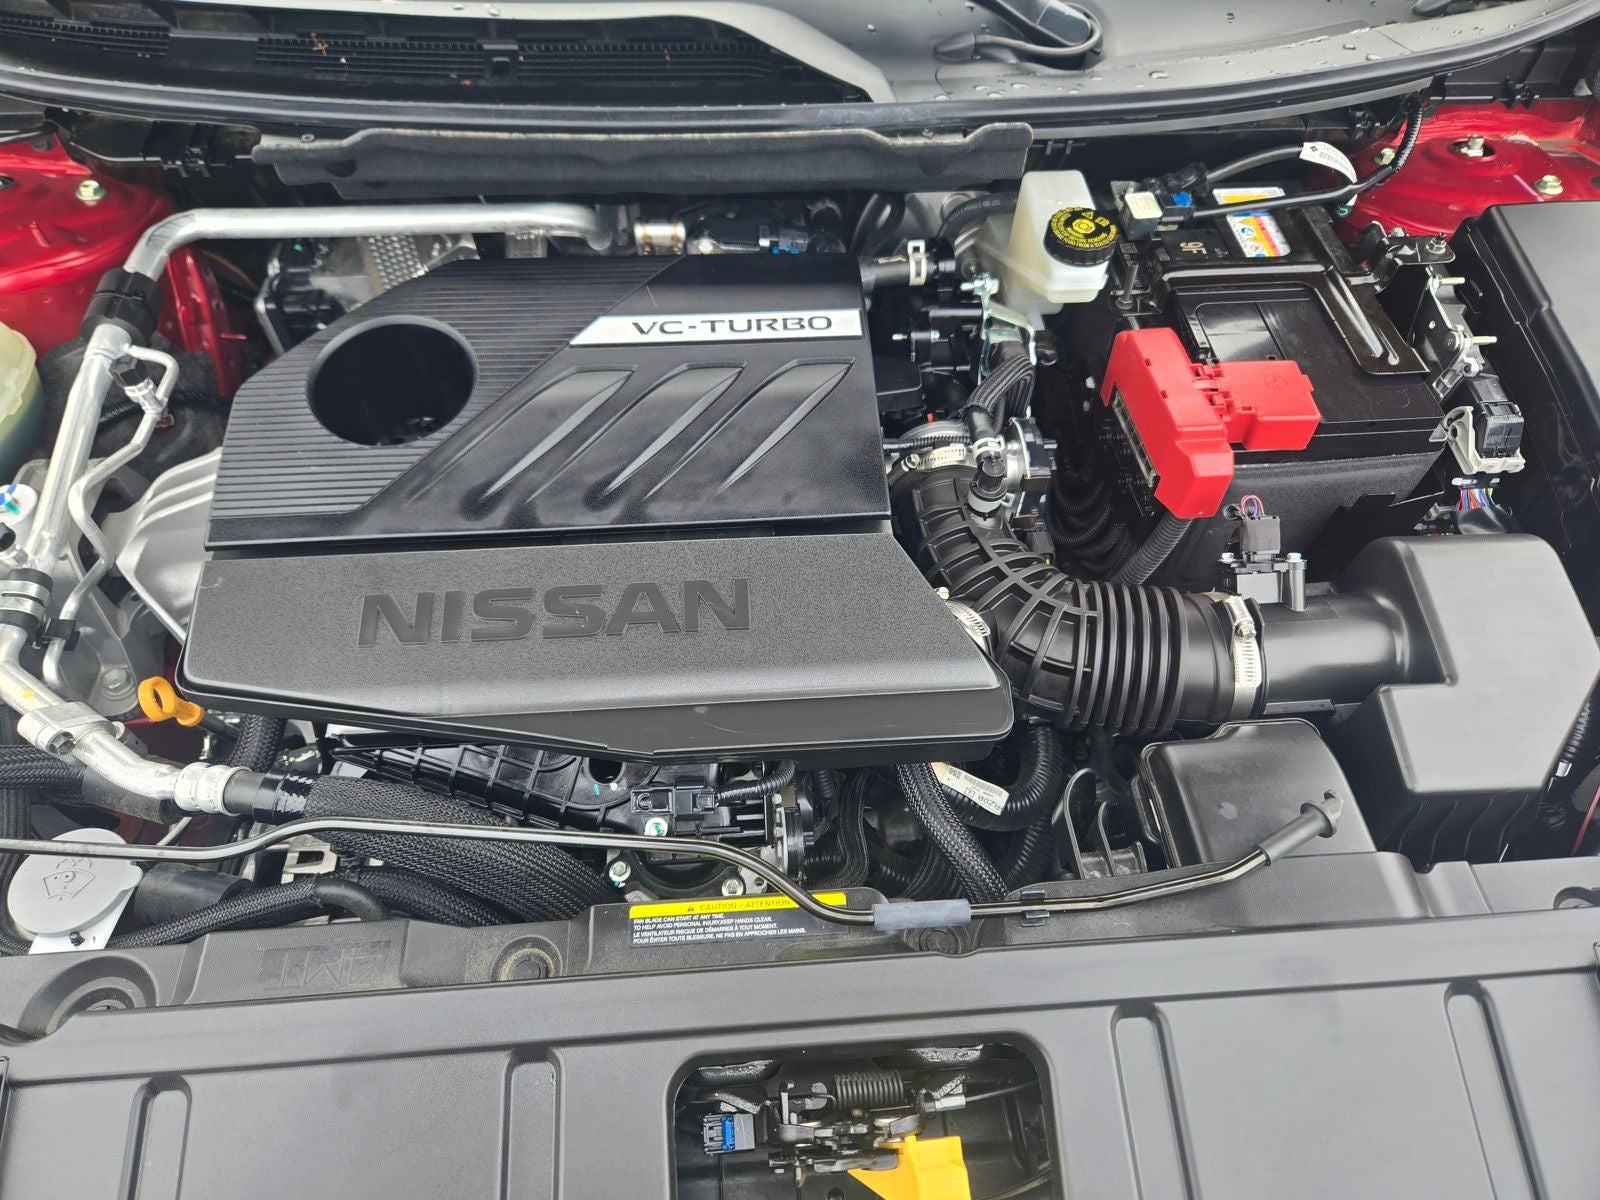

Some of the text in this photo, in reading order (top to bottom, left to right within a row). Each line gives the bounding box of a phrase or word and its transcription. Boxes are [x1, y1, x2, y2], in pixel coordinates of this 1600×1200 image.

[632, 315, 833, 336] VC-TURBO
[358, 578, 750, 647] NISSAN
[700, 902, 736, 911] CAUTION
[745, 899, 789, 908] ATTENTION
